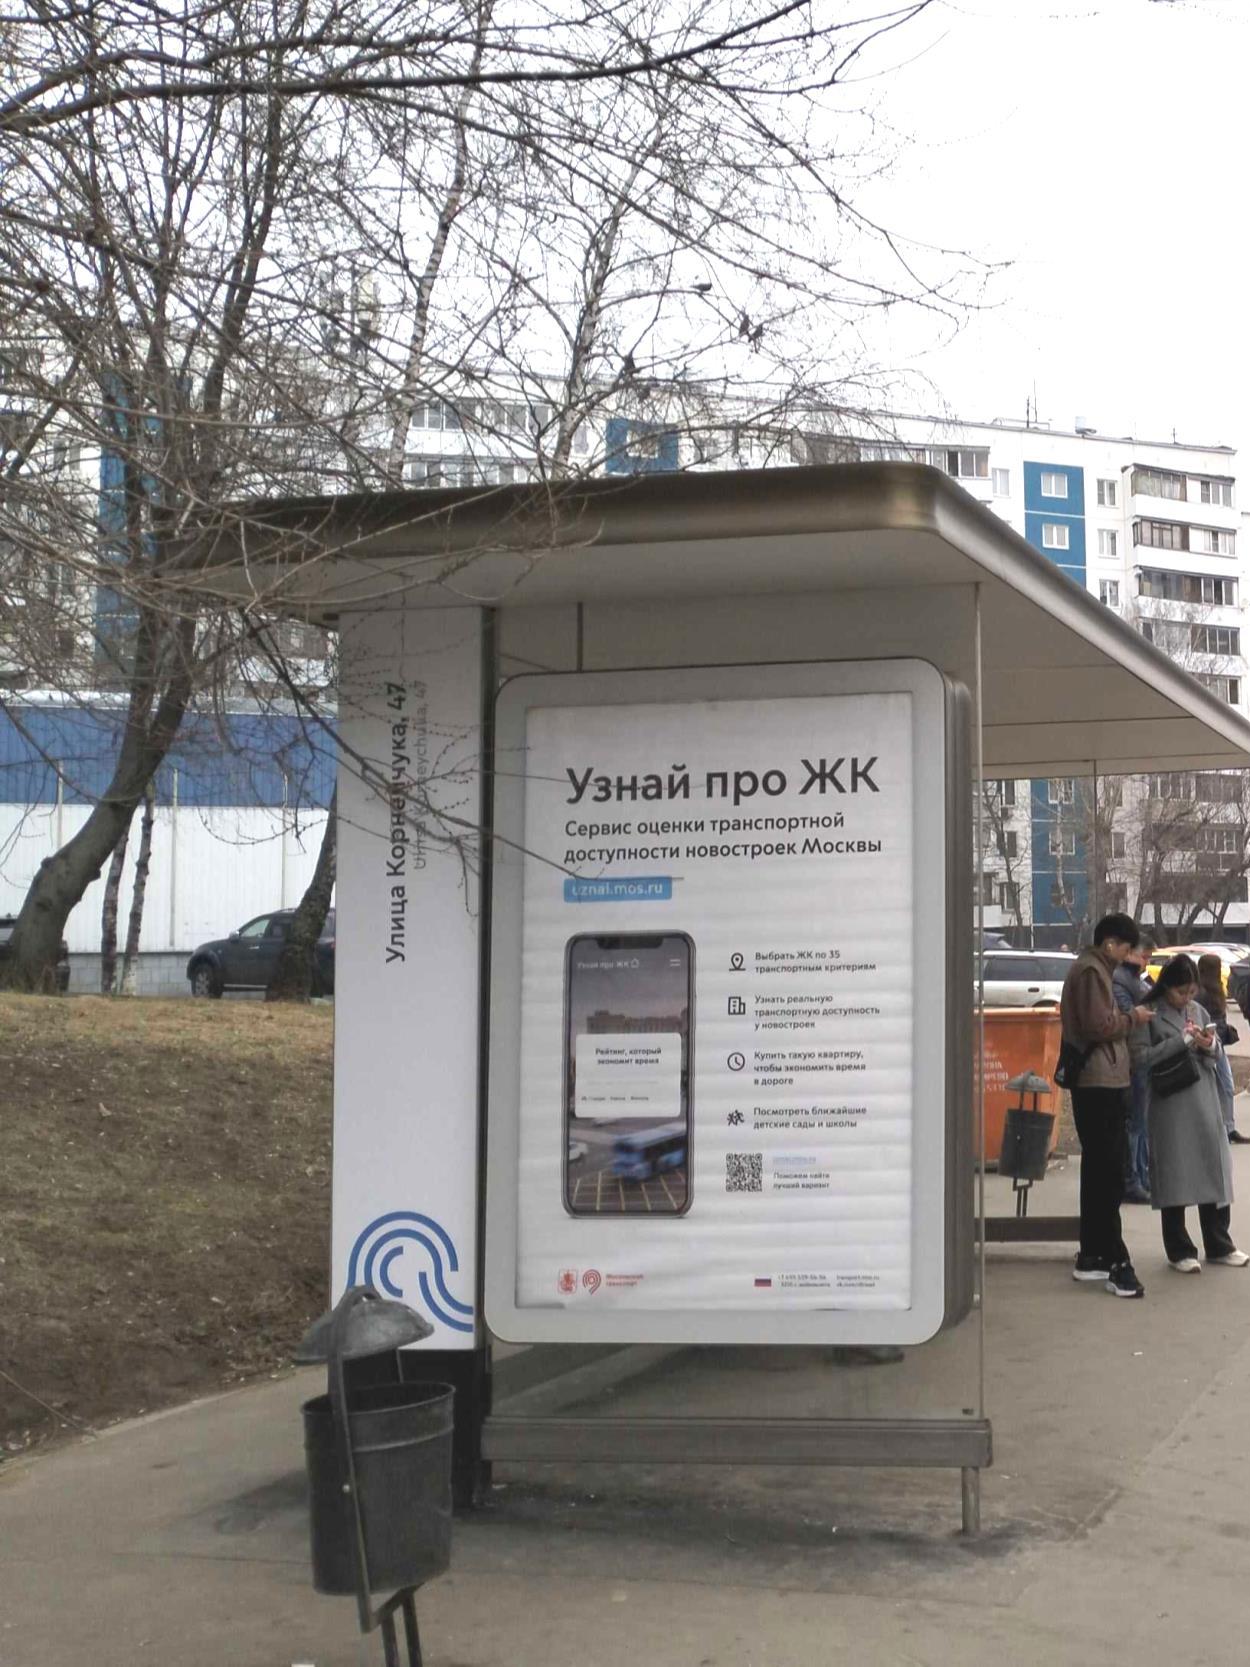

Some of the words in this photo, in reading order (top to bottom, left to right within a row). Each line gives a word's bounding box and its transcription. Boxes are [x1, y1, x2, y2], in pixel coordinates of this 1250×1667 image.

[384, 681, 406, 710] 47
[566, 763, 691, 805] Узнай
[706, 769, 787, 806] про
[799, 756, 880, 795] ЖК
[565, 820, 632, 839] Сервис
[637, 818, 705, 836] оценки
[710, 811, 845, 835] транспортной
[564, 846, 680, 864] доступности
[686, 842, 797, 860] новостроек
[801, 837, 882, 855] Москвы
[385, 885, 408, 964] Улица
[755, 951, 795, 961] Выбрать
[797, 951, 814, 960] ЖК
[815, 952, 827, 960] по
[829, 950, 841, 959] 35
[755, 965, 822, 974] транспортным
[824, 963, 876, 973] критериям
[754, 995, 785, 1004] Узнать
[787, 995, 833, 1004] реальную
[755, 1009, 820, 1018] транспортную
[822, 1006, 880, 1016] доступность
[754, 1023, 760, 1031] у
[762, 1020, 815, 1030] новостроек
[754, 1051, 786, 1061] Купить
[754, 1064, 782, 1073] чтобы
[784, 1064, 834, 1073] экономить
[836, 1063, 866, 1073] время
[761, 1077, 793, 1086] дороге
[753, 1106, 810, 1117] Посмотреть
[811, 1105, 867, 1116] ближайшие
[753, 1121, 790, 1130] детские
[792, 1120, 816, 1129] сады
[825, 1119, 858, 1129] школы
